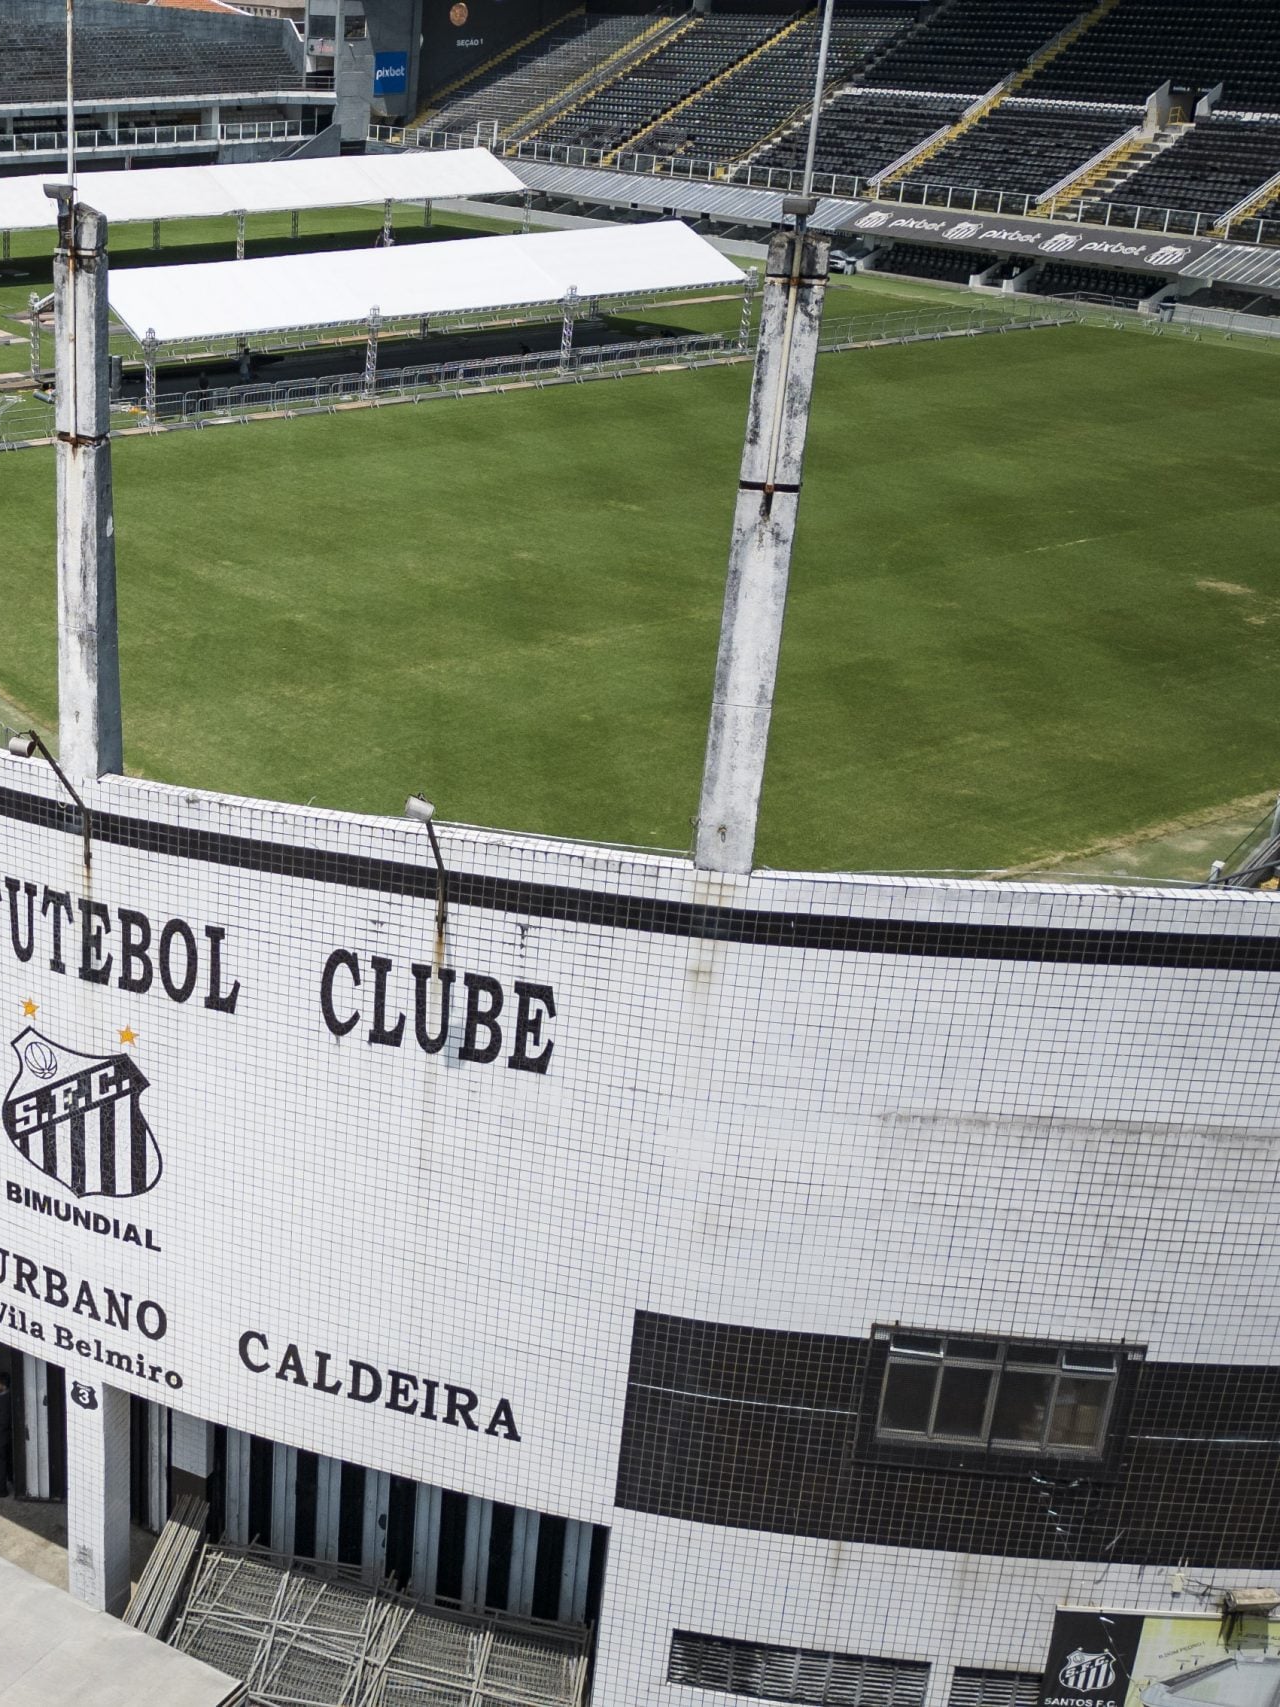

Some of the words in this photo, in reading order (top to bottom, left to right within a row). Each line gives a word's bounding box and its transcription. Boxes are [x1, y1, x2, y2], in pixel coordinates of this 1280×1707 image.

[376, 65, 405, 81] pixbet
[888, 218, 946, 231] pixbet
[978, 228, 1042, 243] pixbet
[1078, 240, 1147, 256] pixbet
[320, 948, 556, 1074] CLUBE
[15, 1065, 131, 1133] S.F.C.
[6, 1180, 162, 1252] BIMUNDIAL
[53, 1323, 183, 1389] Belmiro
[238, 1330, 521, 1442] CALDEIRA
[78, 1389, 90, 1404] 3
[1044, 1697, 1093, 1707] SANTOS
